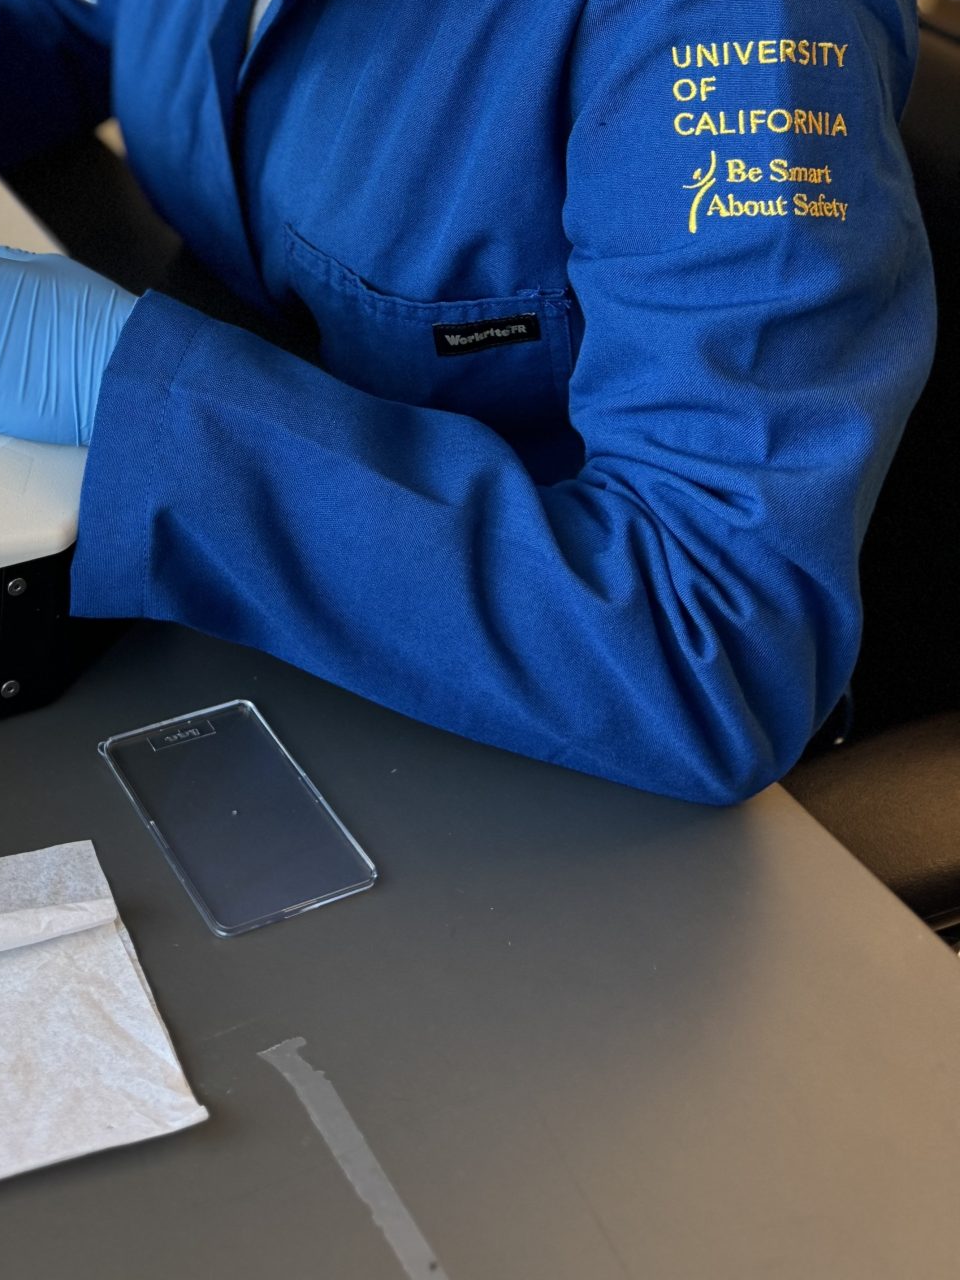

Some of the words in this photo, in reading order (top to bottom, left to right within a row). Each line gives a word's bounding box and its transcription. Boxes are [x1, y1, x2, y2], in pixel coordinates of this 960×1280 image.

[671, 39, 849, 68] UNIVERSITY
[672, 76, 716, 102] OF
[673, 108, 848, 136] CALIFORNIA
[725, 158, 763, 183] Be
[769, 158, 832, 184] Smart
[706, 193, 788, 217] About
[792, 193, 848, 221] Safety
